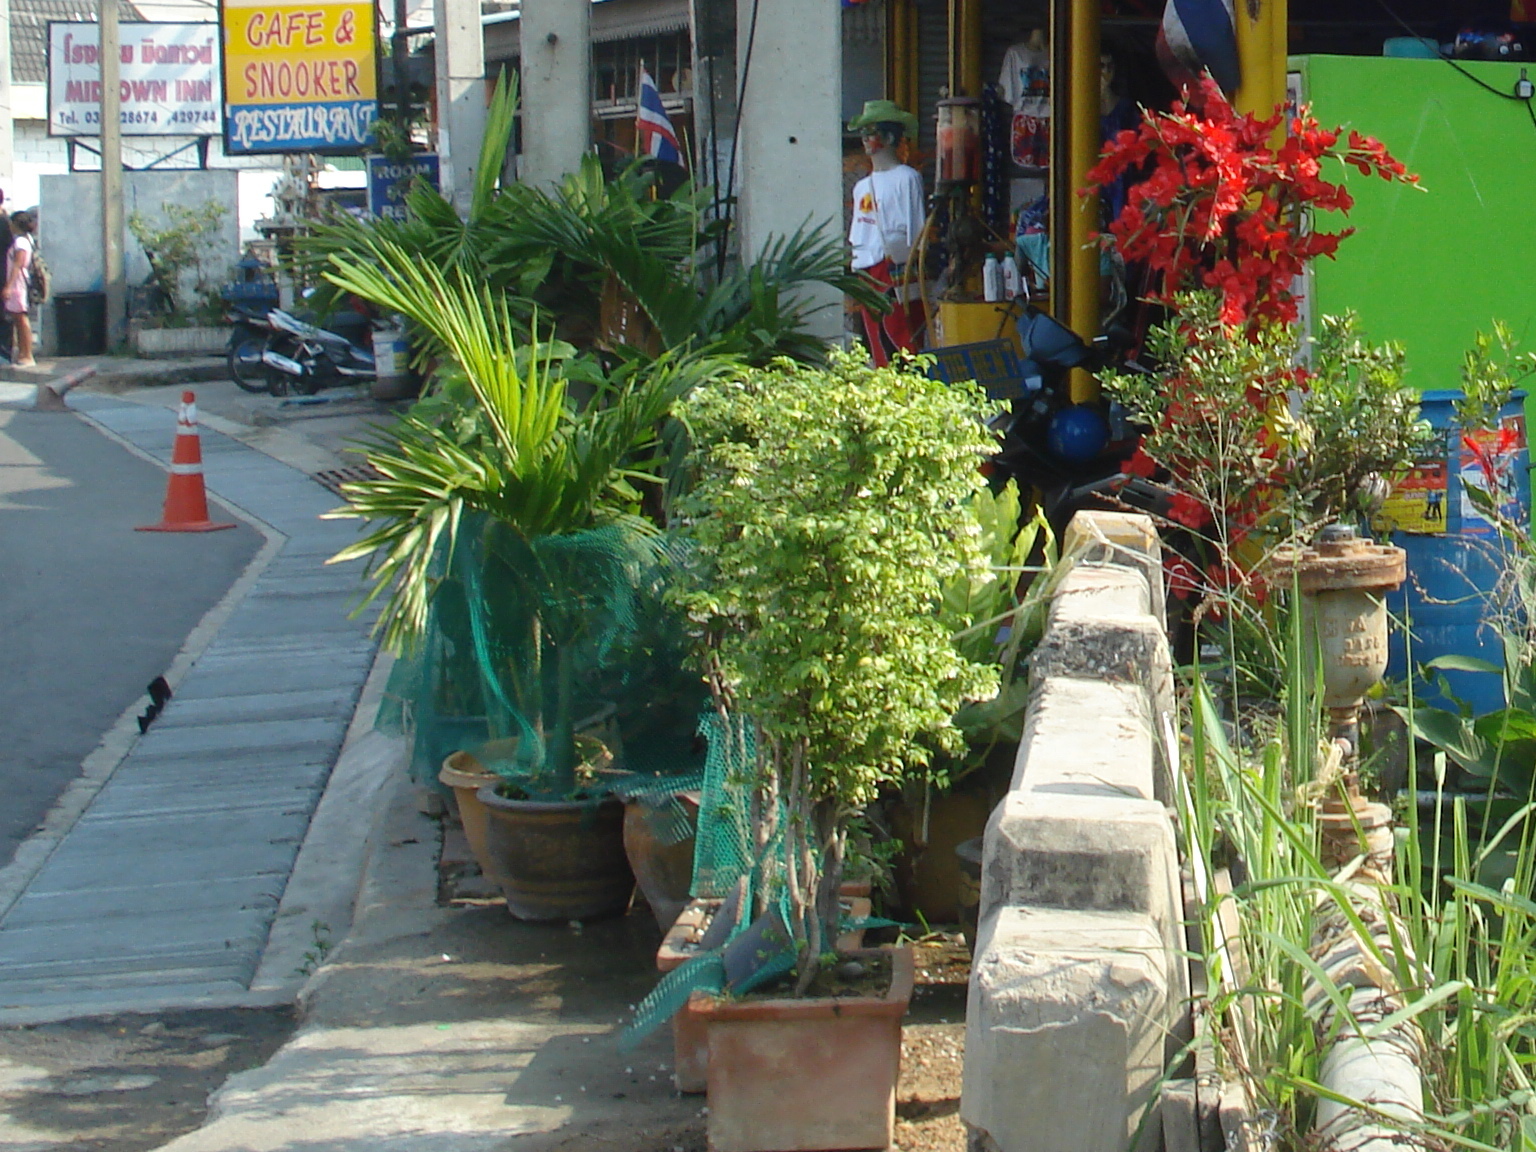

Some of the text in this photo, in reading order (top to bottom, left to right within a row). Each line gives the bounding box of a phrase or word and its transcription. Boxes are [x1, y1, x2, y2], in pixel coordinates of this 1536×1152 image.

[246, 9, 354, 48] CAFE &
[175, 78, 212, 102] INN
[244, 59, 361, 98] SNOOKER
[232, 102, 376, 149] RESTAURANT
[375, 163, 431, 179] ROOM
